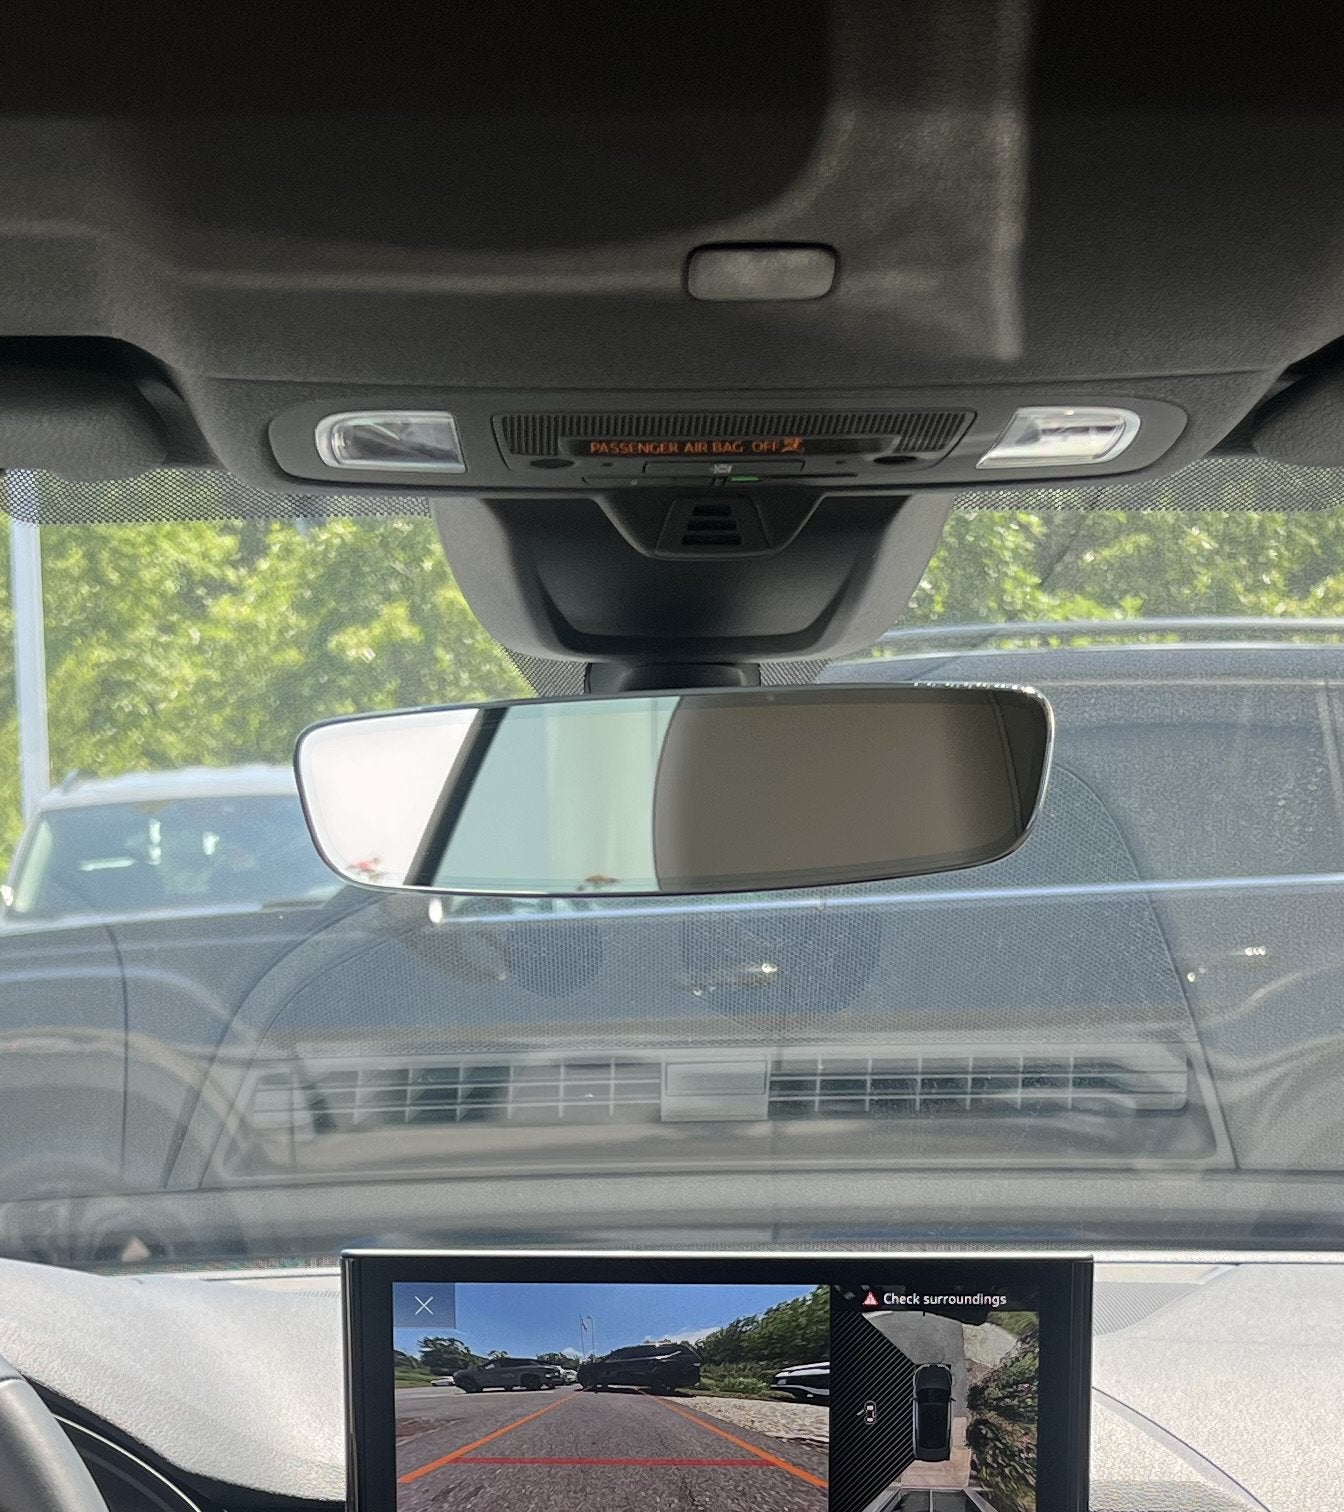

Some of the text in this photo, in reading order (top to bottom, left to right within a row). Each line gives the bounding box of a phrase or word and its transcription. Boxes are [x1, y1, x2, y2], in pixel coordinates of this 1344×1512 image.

[590, 441, 678, 454] PASSENGER
[684, 441, 707, 453] AIR
[712, 440, 743, 453] BAG
[883, 1291, 1007, 1308] Check surroundings
